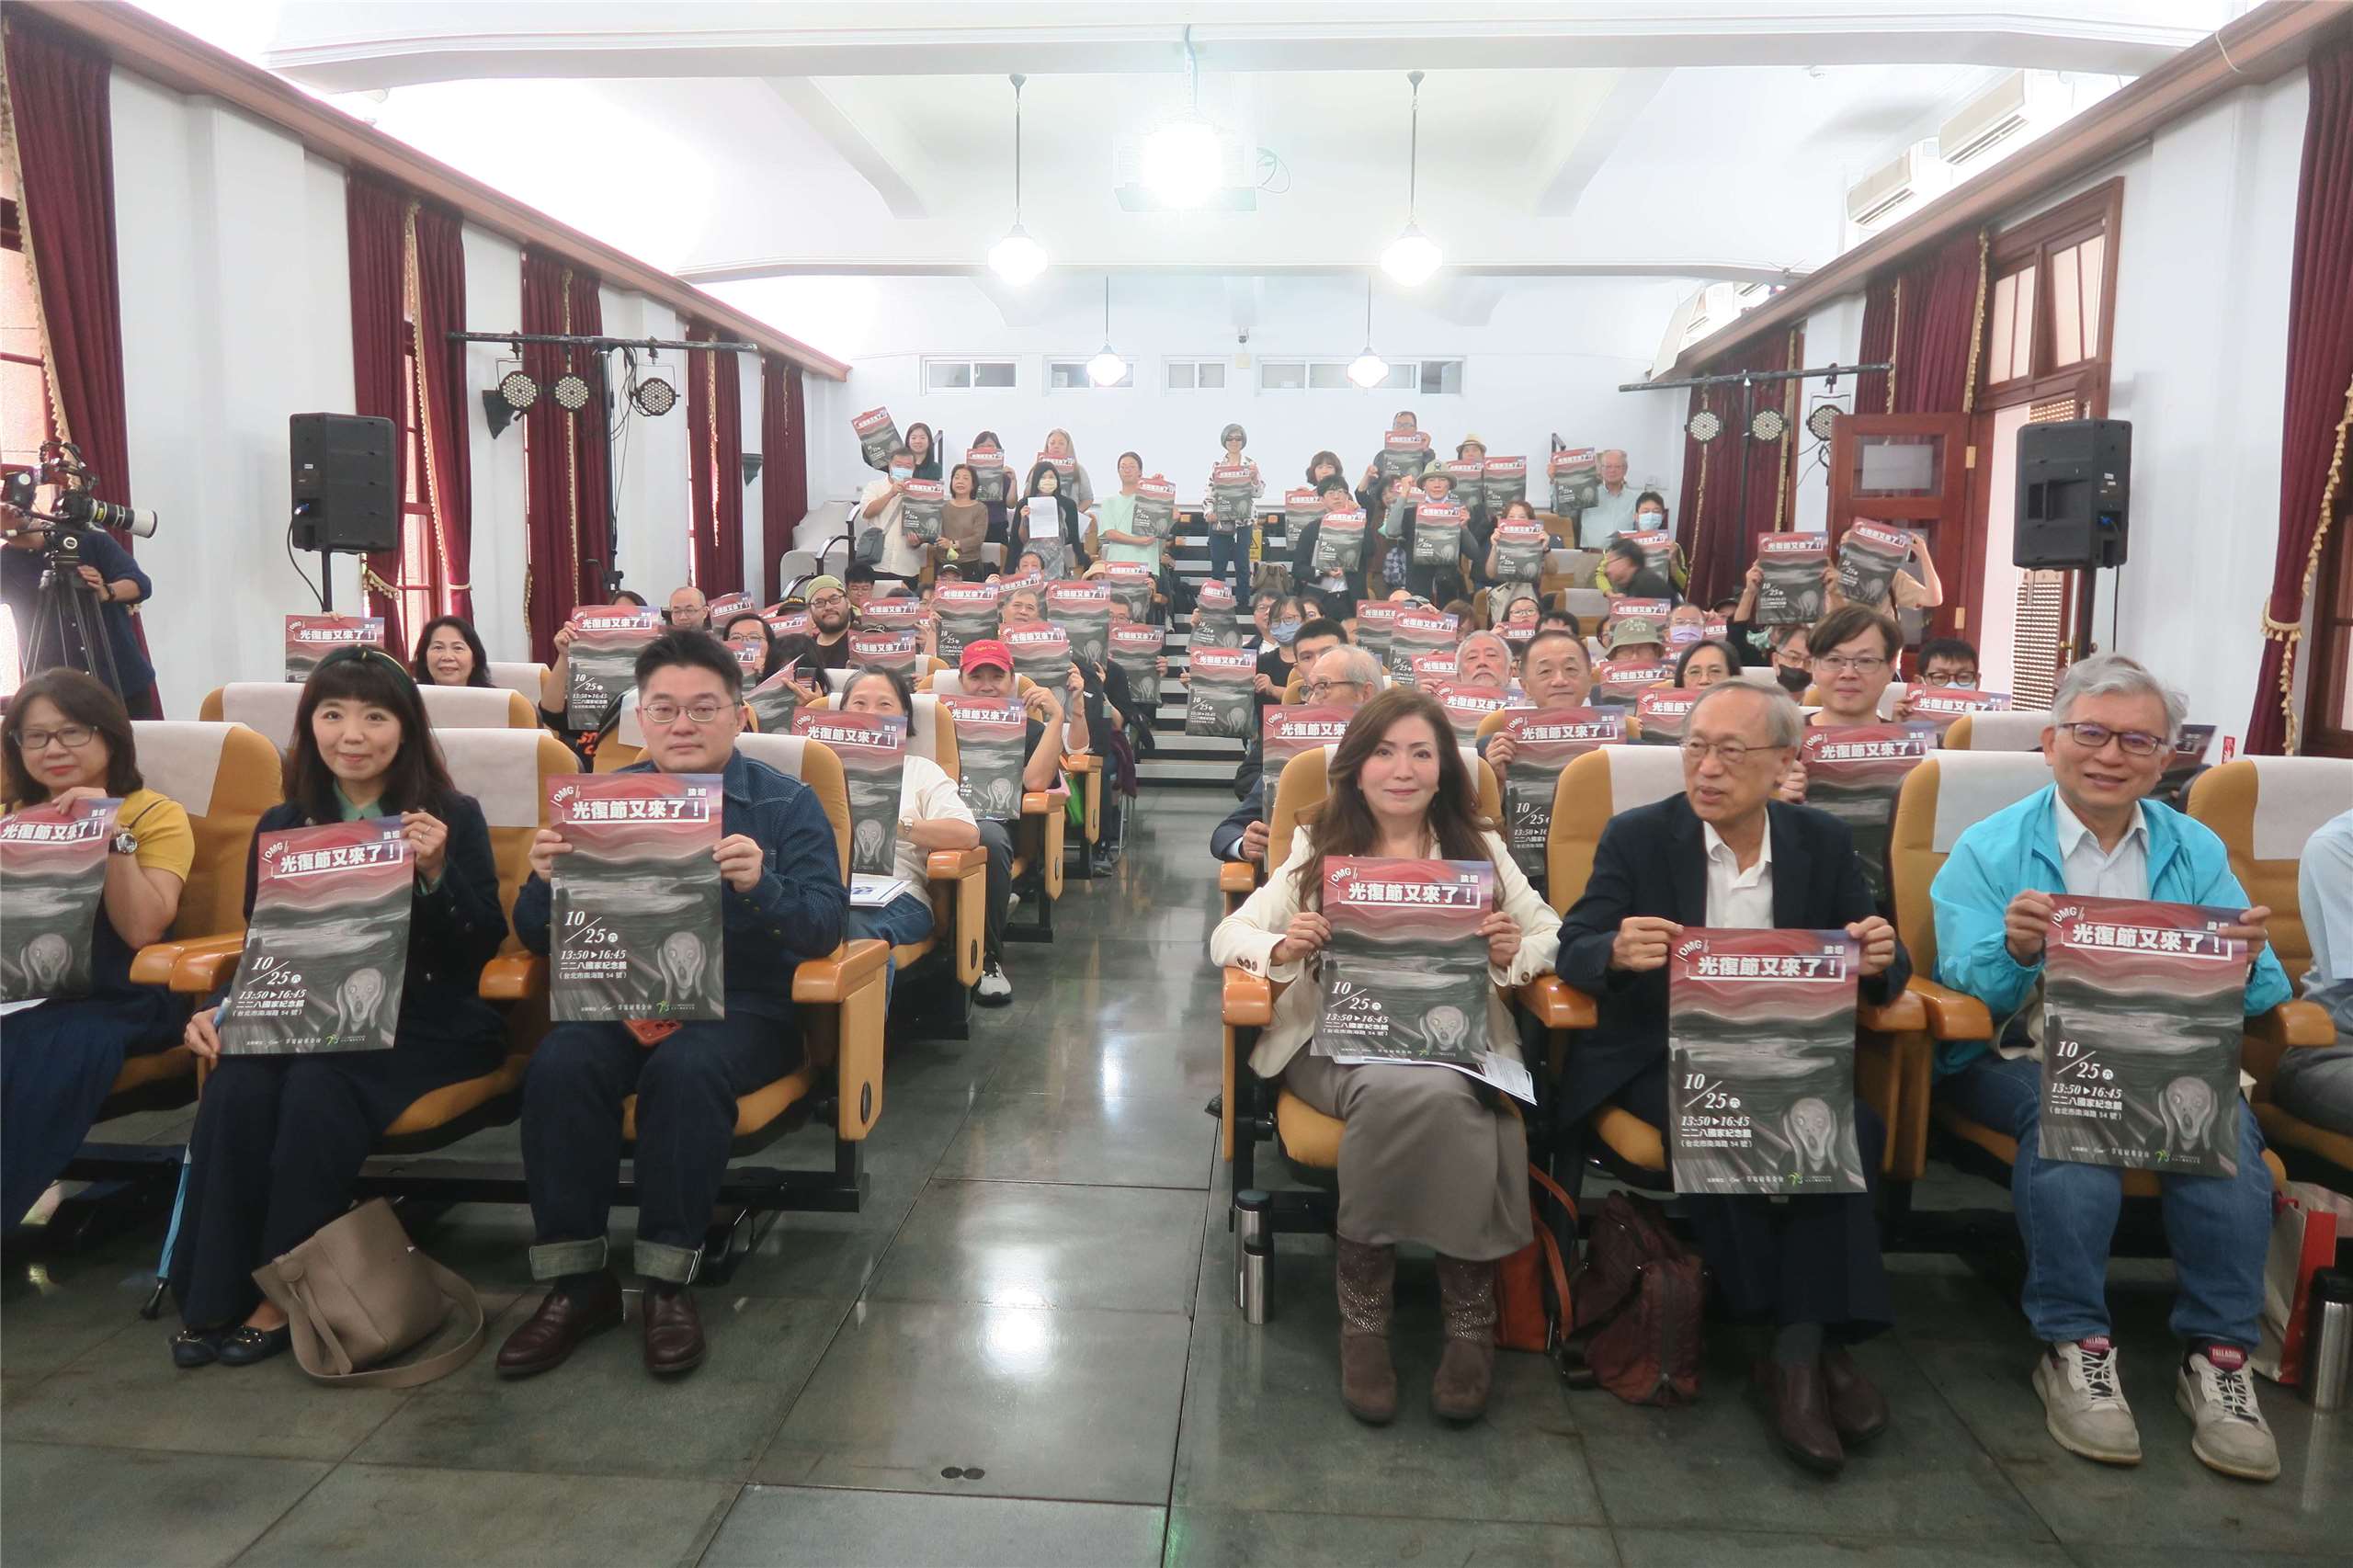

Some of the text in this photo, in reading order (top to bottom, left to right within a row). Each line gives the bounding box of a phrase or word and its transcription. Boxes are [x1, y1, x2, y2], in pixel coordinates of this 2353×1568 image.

[1281, 722, 1347, 735] 光復節又來
[1522, 725, 1610, 740] 光復節又來了！
[1821, 742, 1921, 759] 光復節又來了！
[553, 786, 574, 802] OMG
[573, 800, 700, 820] 光復節又來了！
[1516, 802, 1529, 813] 10
[1530, 814, 1544, 824] 25
[265, 842, 283, 859] OMG
[280, 844, 394, 873] 光復節又來了！
[1332, 868, 1351, 882] OMG
[1349, 882, 1471, 903] 光復節又來了！
[564, 911, 585, 926] 10
[2053, 906, 2077, 923] OMG
[585, 928, 606, 943] 25
[2073, 924, 2221, 953] 光復節又來了！
[561, 949, 627, 960] 13:50 16:45
[1679, 939, 1702, 956] OMG
[252, 957, 274, 971] 10
[1699, 956, 1836, 977] 光復節又來了！
[267, 971, 289, 985] 25
[239, 989, 307, 1000] 13:50 16:45
[1332, 982, 1351, 994] 10
[1349, 998, 1370, 1010] 25
[1362, 1015, 1389, 1024] 16:45
[2056, 1040, 2078, 1058] 10
[2076, 1062, 2100, 1079] 25
[1684, 1074, 1705, 1090] 10
[2052, 1083, 2122, 1098] 13:50 16:45
[1704, 1093, 1727, 1108] 25
[1681, 1116, 1750, 1126] 13:50 16:45
